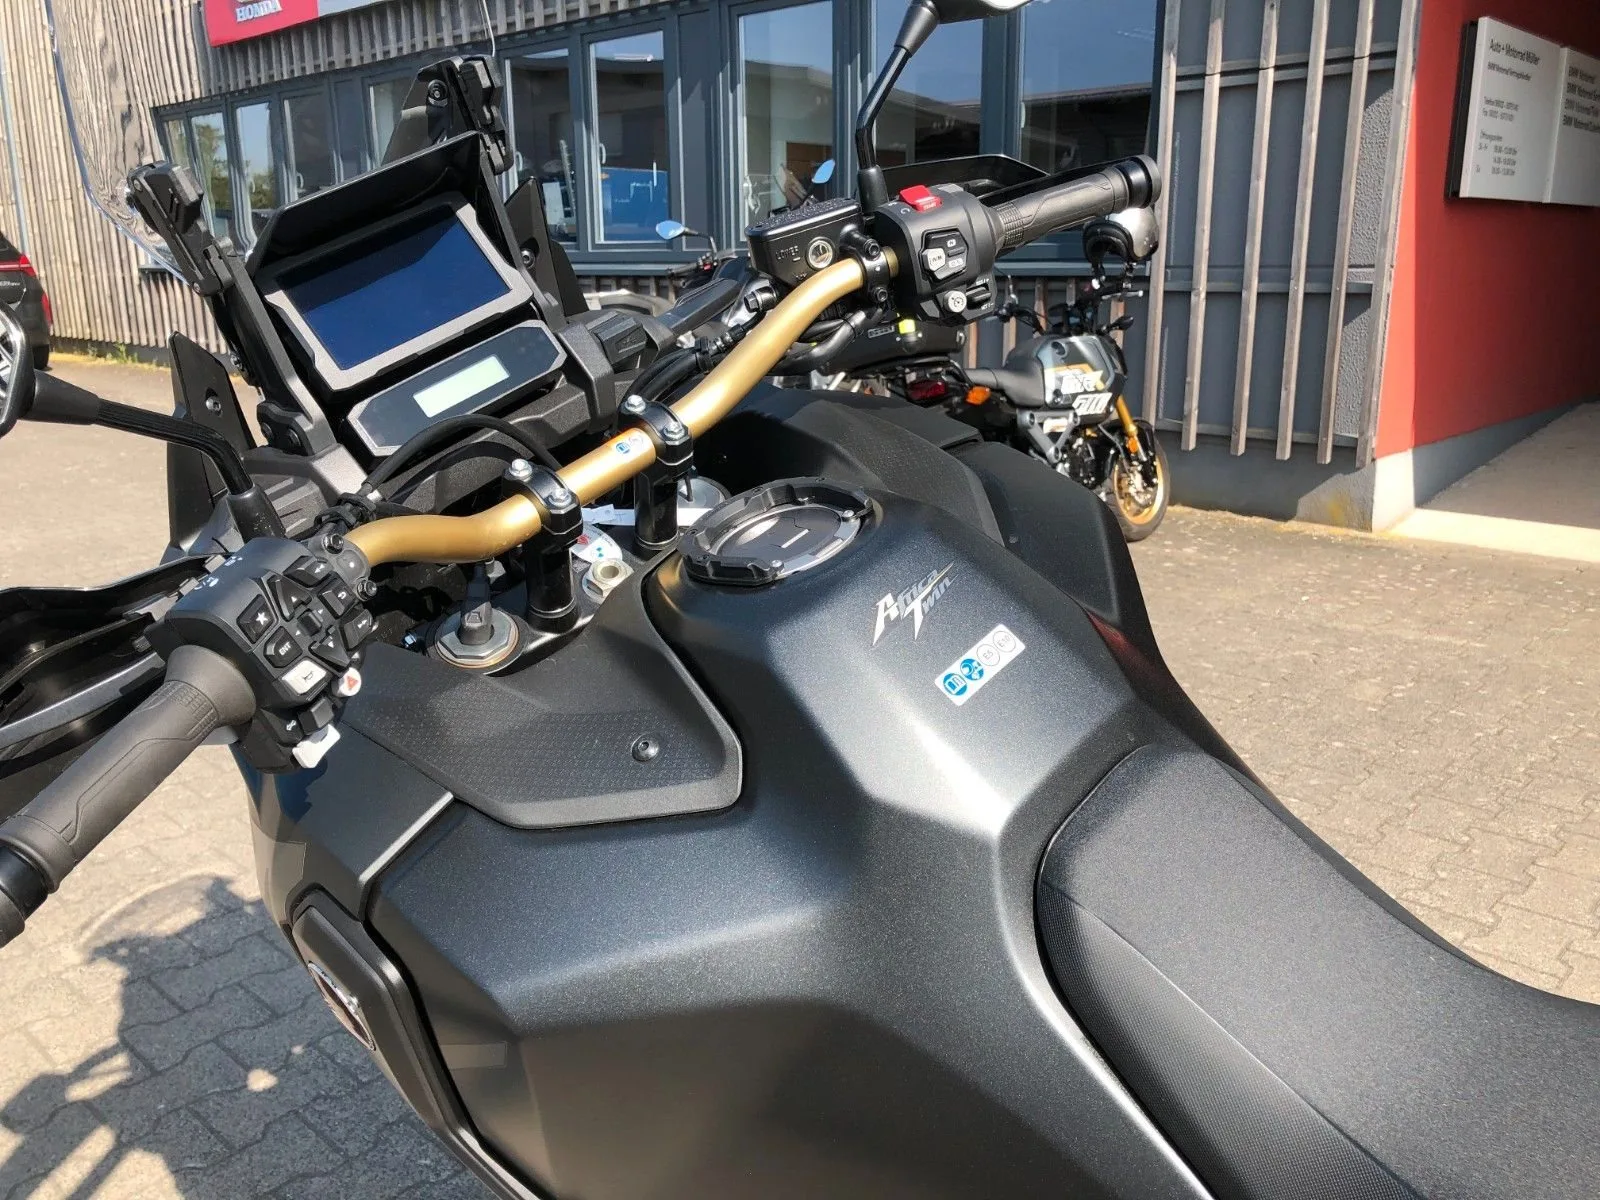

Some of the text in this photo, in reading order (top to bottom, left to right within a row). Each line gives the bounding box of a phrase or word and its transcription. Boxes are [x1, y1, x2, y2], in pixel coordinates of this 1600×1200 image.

[236, 0, 283, 22] HONDA
[872, 569, 940, 646] Africa
[903, 560, 960, 642] Twin
[278, 641, 292, 656] ENT
